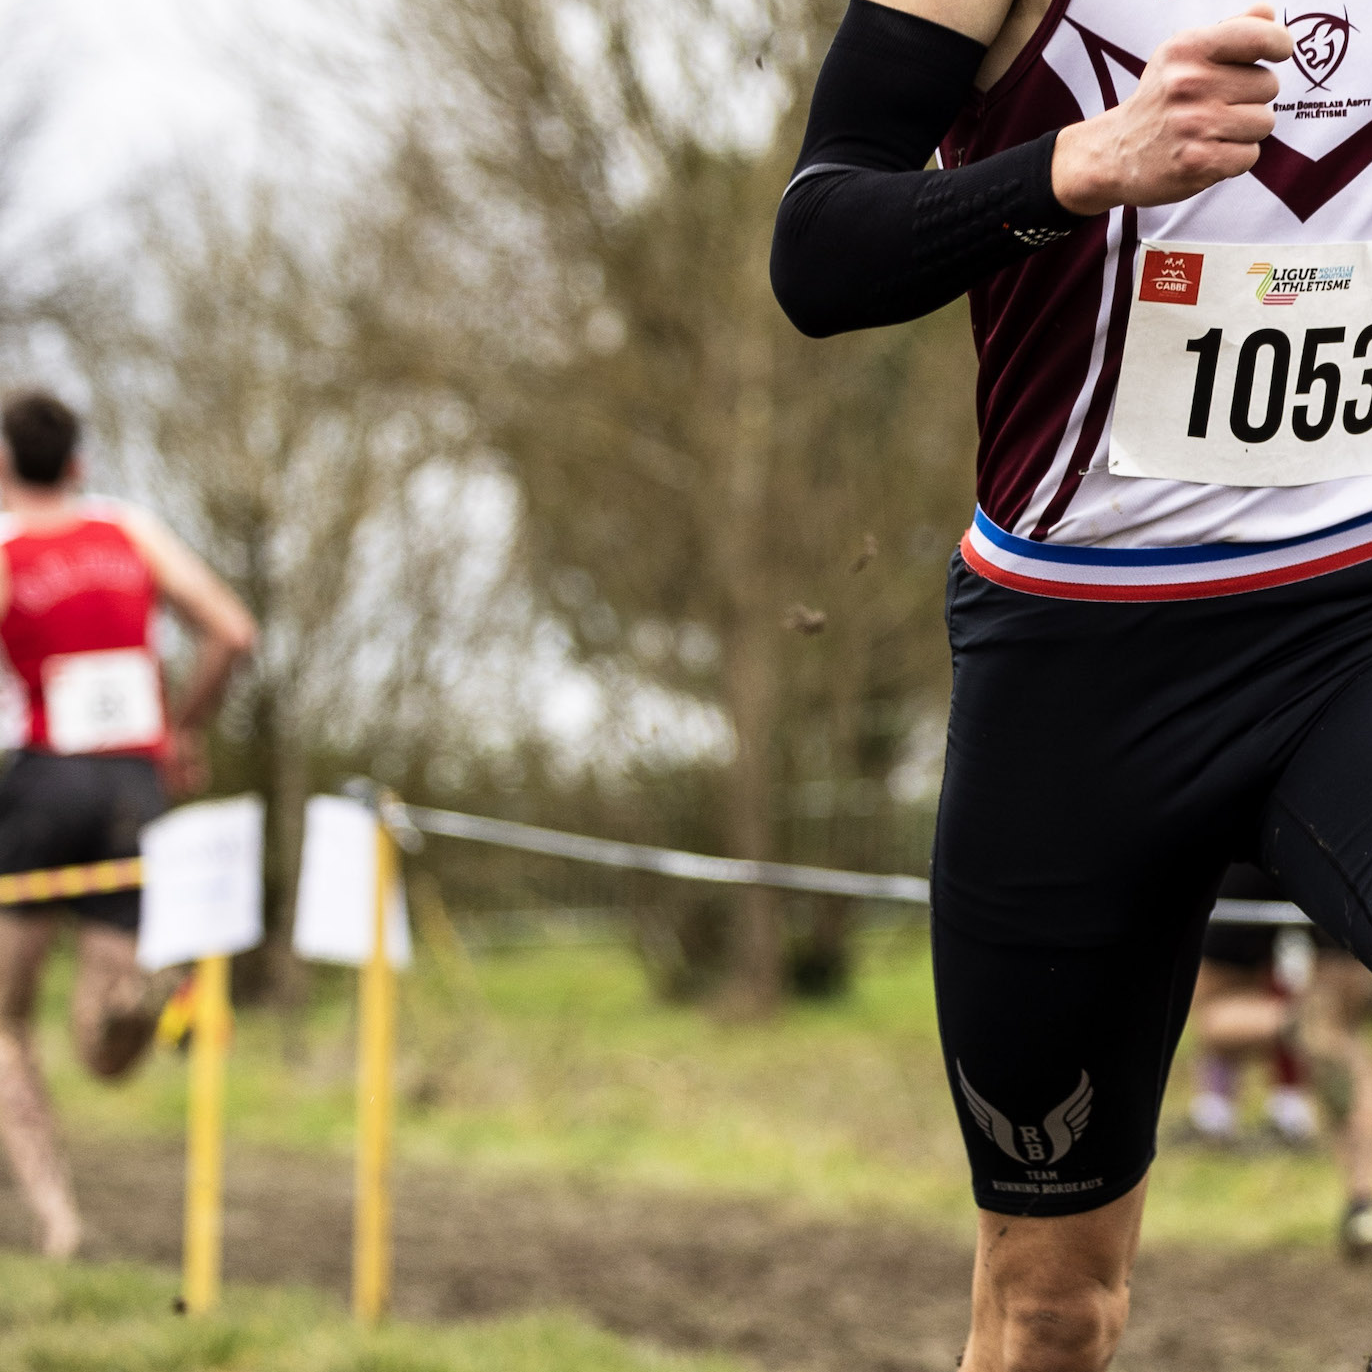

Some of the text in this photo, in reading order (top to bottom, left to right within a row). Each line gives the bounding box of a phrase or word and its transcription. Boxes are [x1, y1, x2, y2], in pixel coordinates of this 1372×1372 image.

[1272, 268, 1318, 281] LIGUE
[1155, 281, 1188, 292] CABBE
[1271, 279, 1351, 293] ATHLETISME
[1025, 1170, 1058, 1180] TEAM
[1041, 1177, 1103, 1194] BORDEAUX
